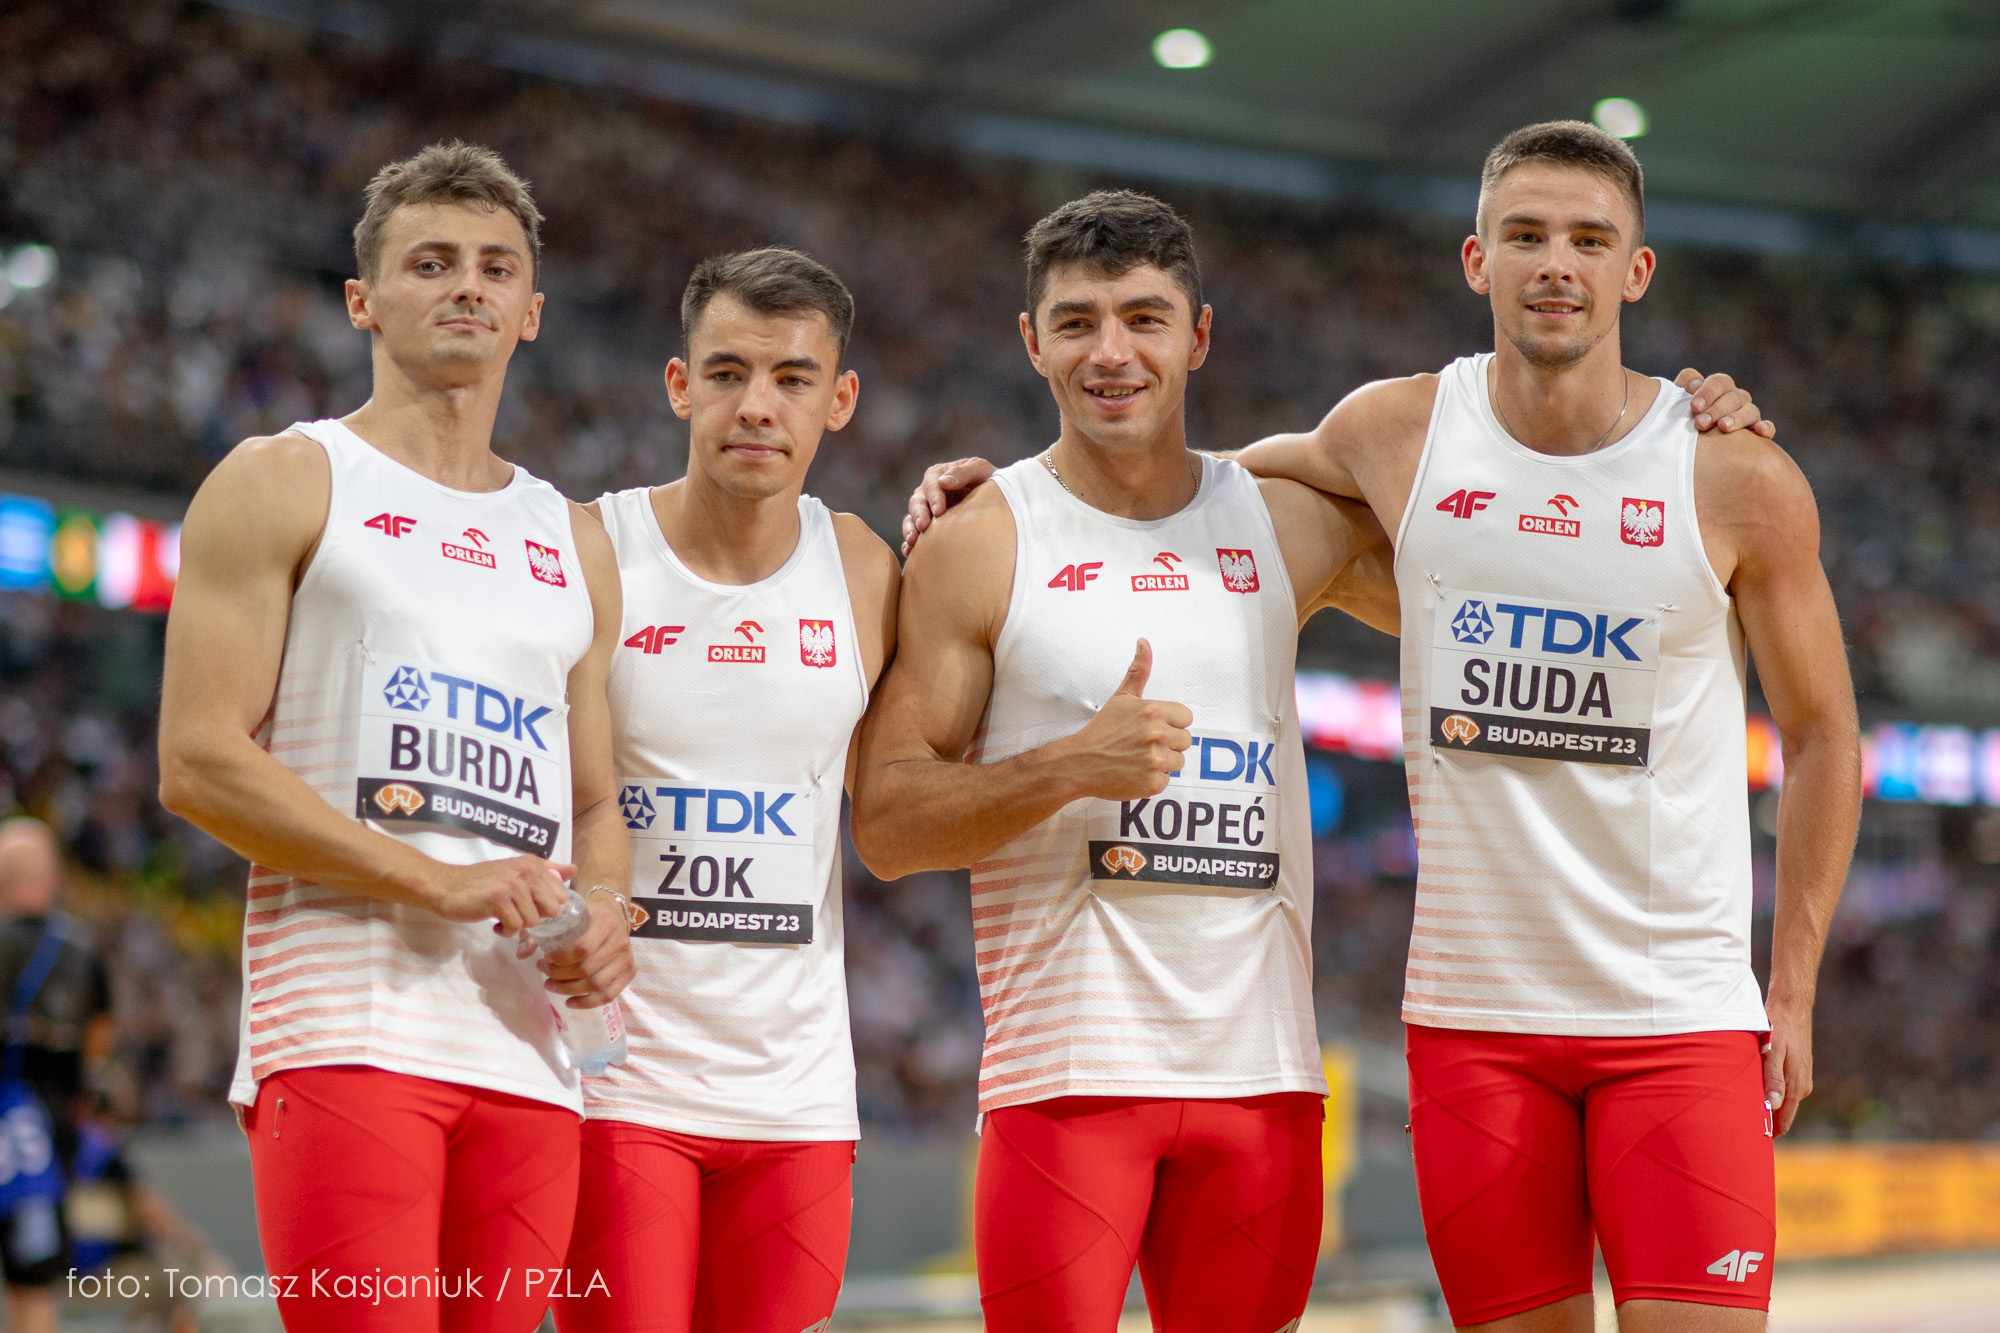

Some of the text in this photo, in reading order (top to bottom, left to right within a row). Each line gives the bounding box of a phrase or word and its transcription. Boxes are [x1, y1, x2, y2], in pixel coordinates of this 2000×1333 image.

[1436, 489, 1496, 519] 4F
[363, 512, 417, 538] 4F
[1522, 517, 1577, 536] ORLEN
[443, 546, 493, 567] ORLEN
[1047, 561, 1103, 591] 4F
[1133, 576, 1186, 590] ORLEN
[624, 625, 686, 654] 4F
[1496, 602, 1645, 662] TDK
[711, 647, 763, 661] ORLEN
[1461, 658, 1613, 719] SIUDA
[431, 671, 554, 752] TDK
[1487, 726, 1637, 755] BUDAPEST 23
[390, 723, 541, 806] BURDA
[1168, 736, 1276, 786] DK
[431, 794, 549, 847] BUDAPEST 23
[656, 786, 797, 836] TDK
[1120, 796, 1266, 847] KOPEĆ
[657, 845, 755, 899] ŻOK
[1153, 855, 1275, 879] BUDAPEST 23
[657, 910, 800, 932] BUDAPEST 23
[1706, 1249, 1765, 1283] 4F
